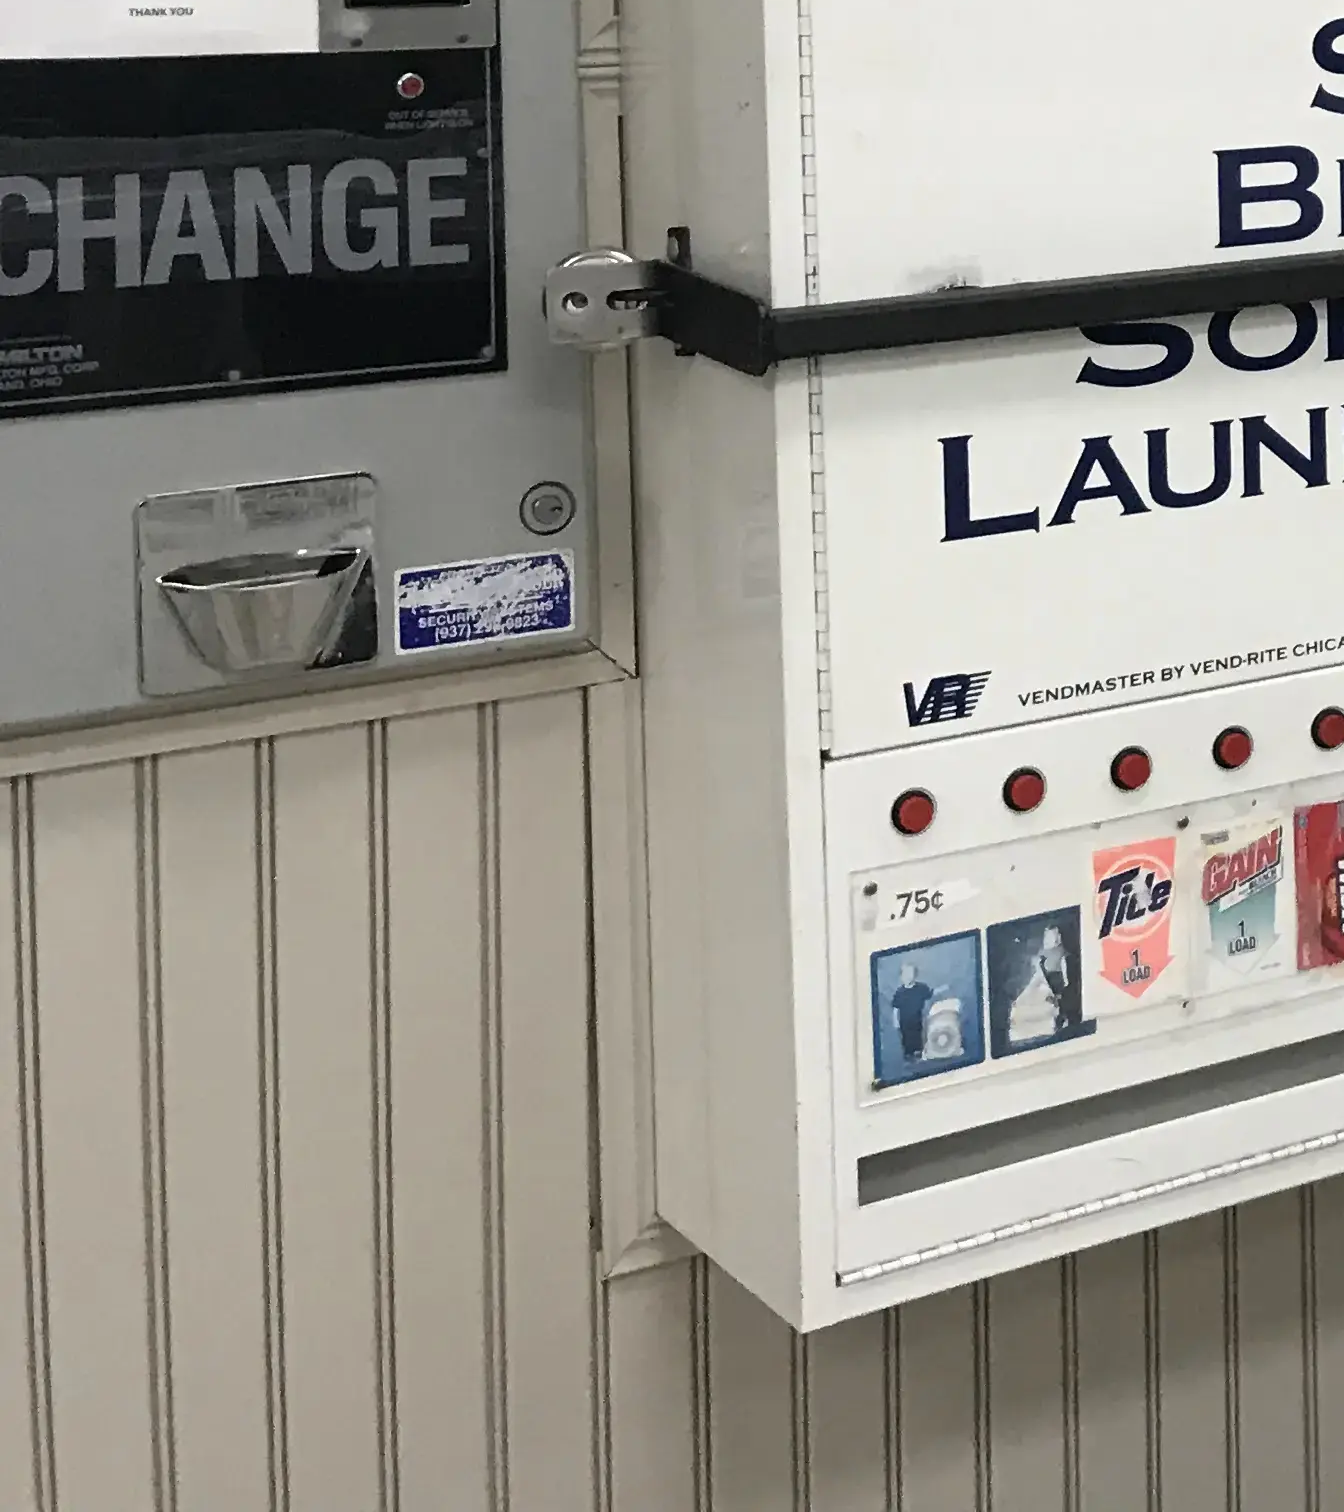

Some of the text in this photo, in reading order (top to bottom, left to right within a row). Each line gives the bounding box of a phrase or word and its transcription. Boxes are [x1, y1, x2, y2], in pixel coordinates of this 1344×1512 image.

[128, 7, 194, 17] THANK YOU
[0, 157, 470, 297] CHANGE
[435, 622, 471, 643] (937)
[1018, 670, 1155, 707] VENDMASTER
[1161, 664, 1185, 682] BY
[1190, 646, 1288, 676] VEND-RITE
[1201, 825, 1283, 906] GAIN
[889, 888, 944, 922] .75¢
[1237, 919, 1246, 938] 1
[1228, 935, 1256, 956] LOAD
[1131, 949, 1140, 967] 1
[1123, 965, 1151, 985] LOAD
